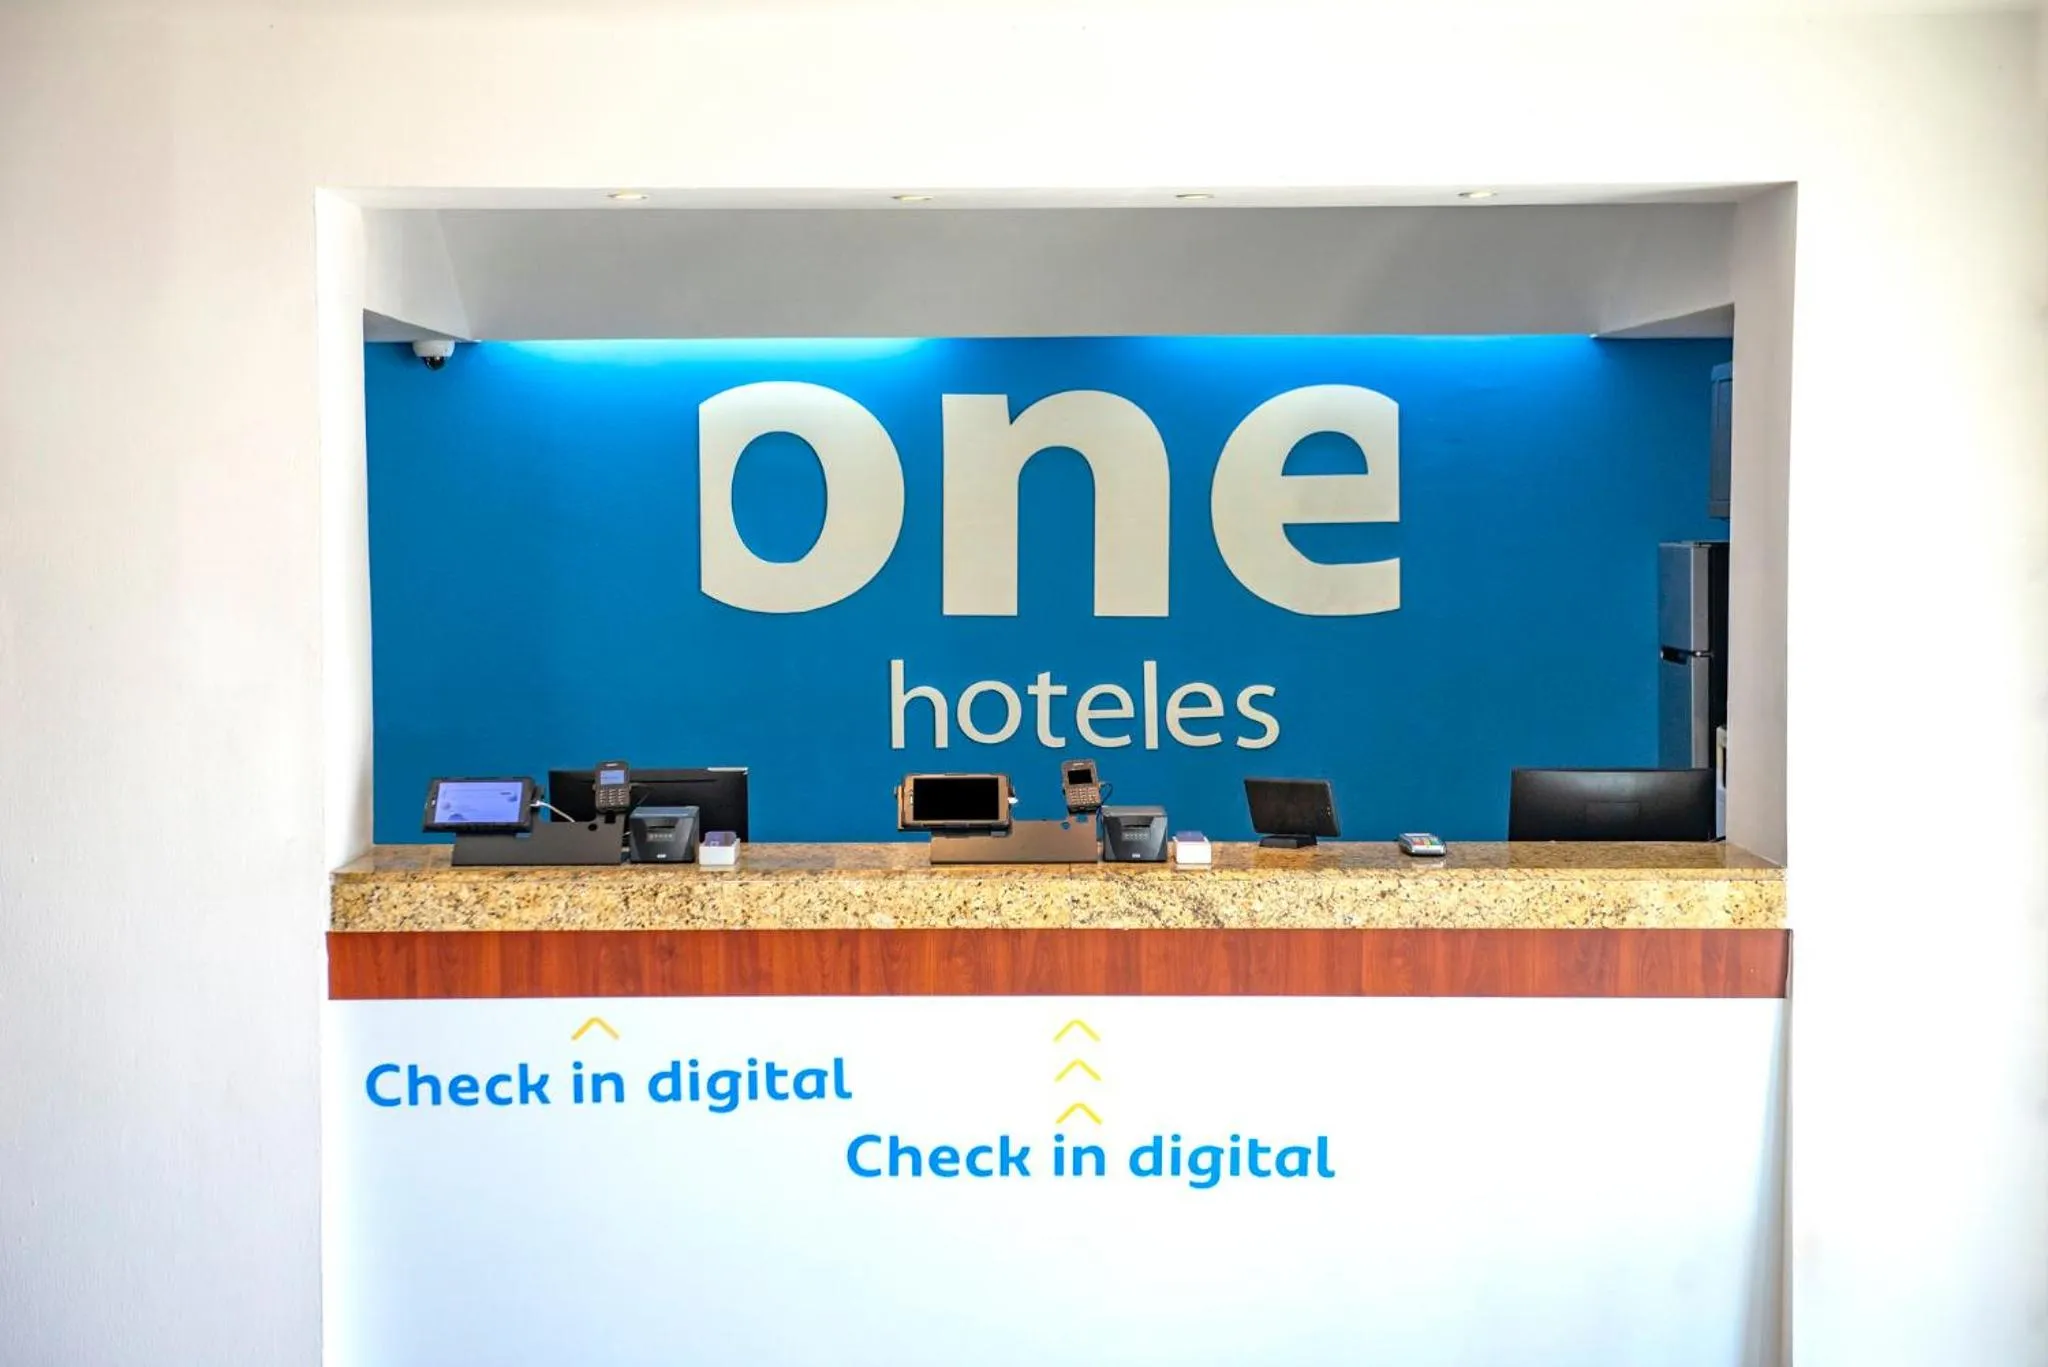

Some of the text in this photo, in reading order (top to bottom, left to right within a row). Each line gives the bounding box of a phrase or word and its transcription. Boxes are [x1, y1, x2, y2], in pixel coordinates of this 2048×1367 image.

[698, 381, 1401, 617] one
[891, 659, 1280, 750] hoteles
[364, 1057, 853, 1115] Check in digital
[846, 1133, 1336, 1190] Check in digital
